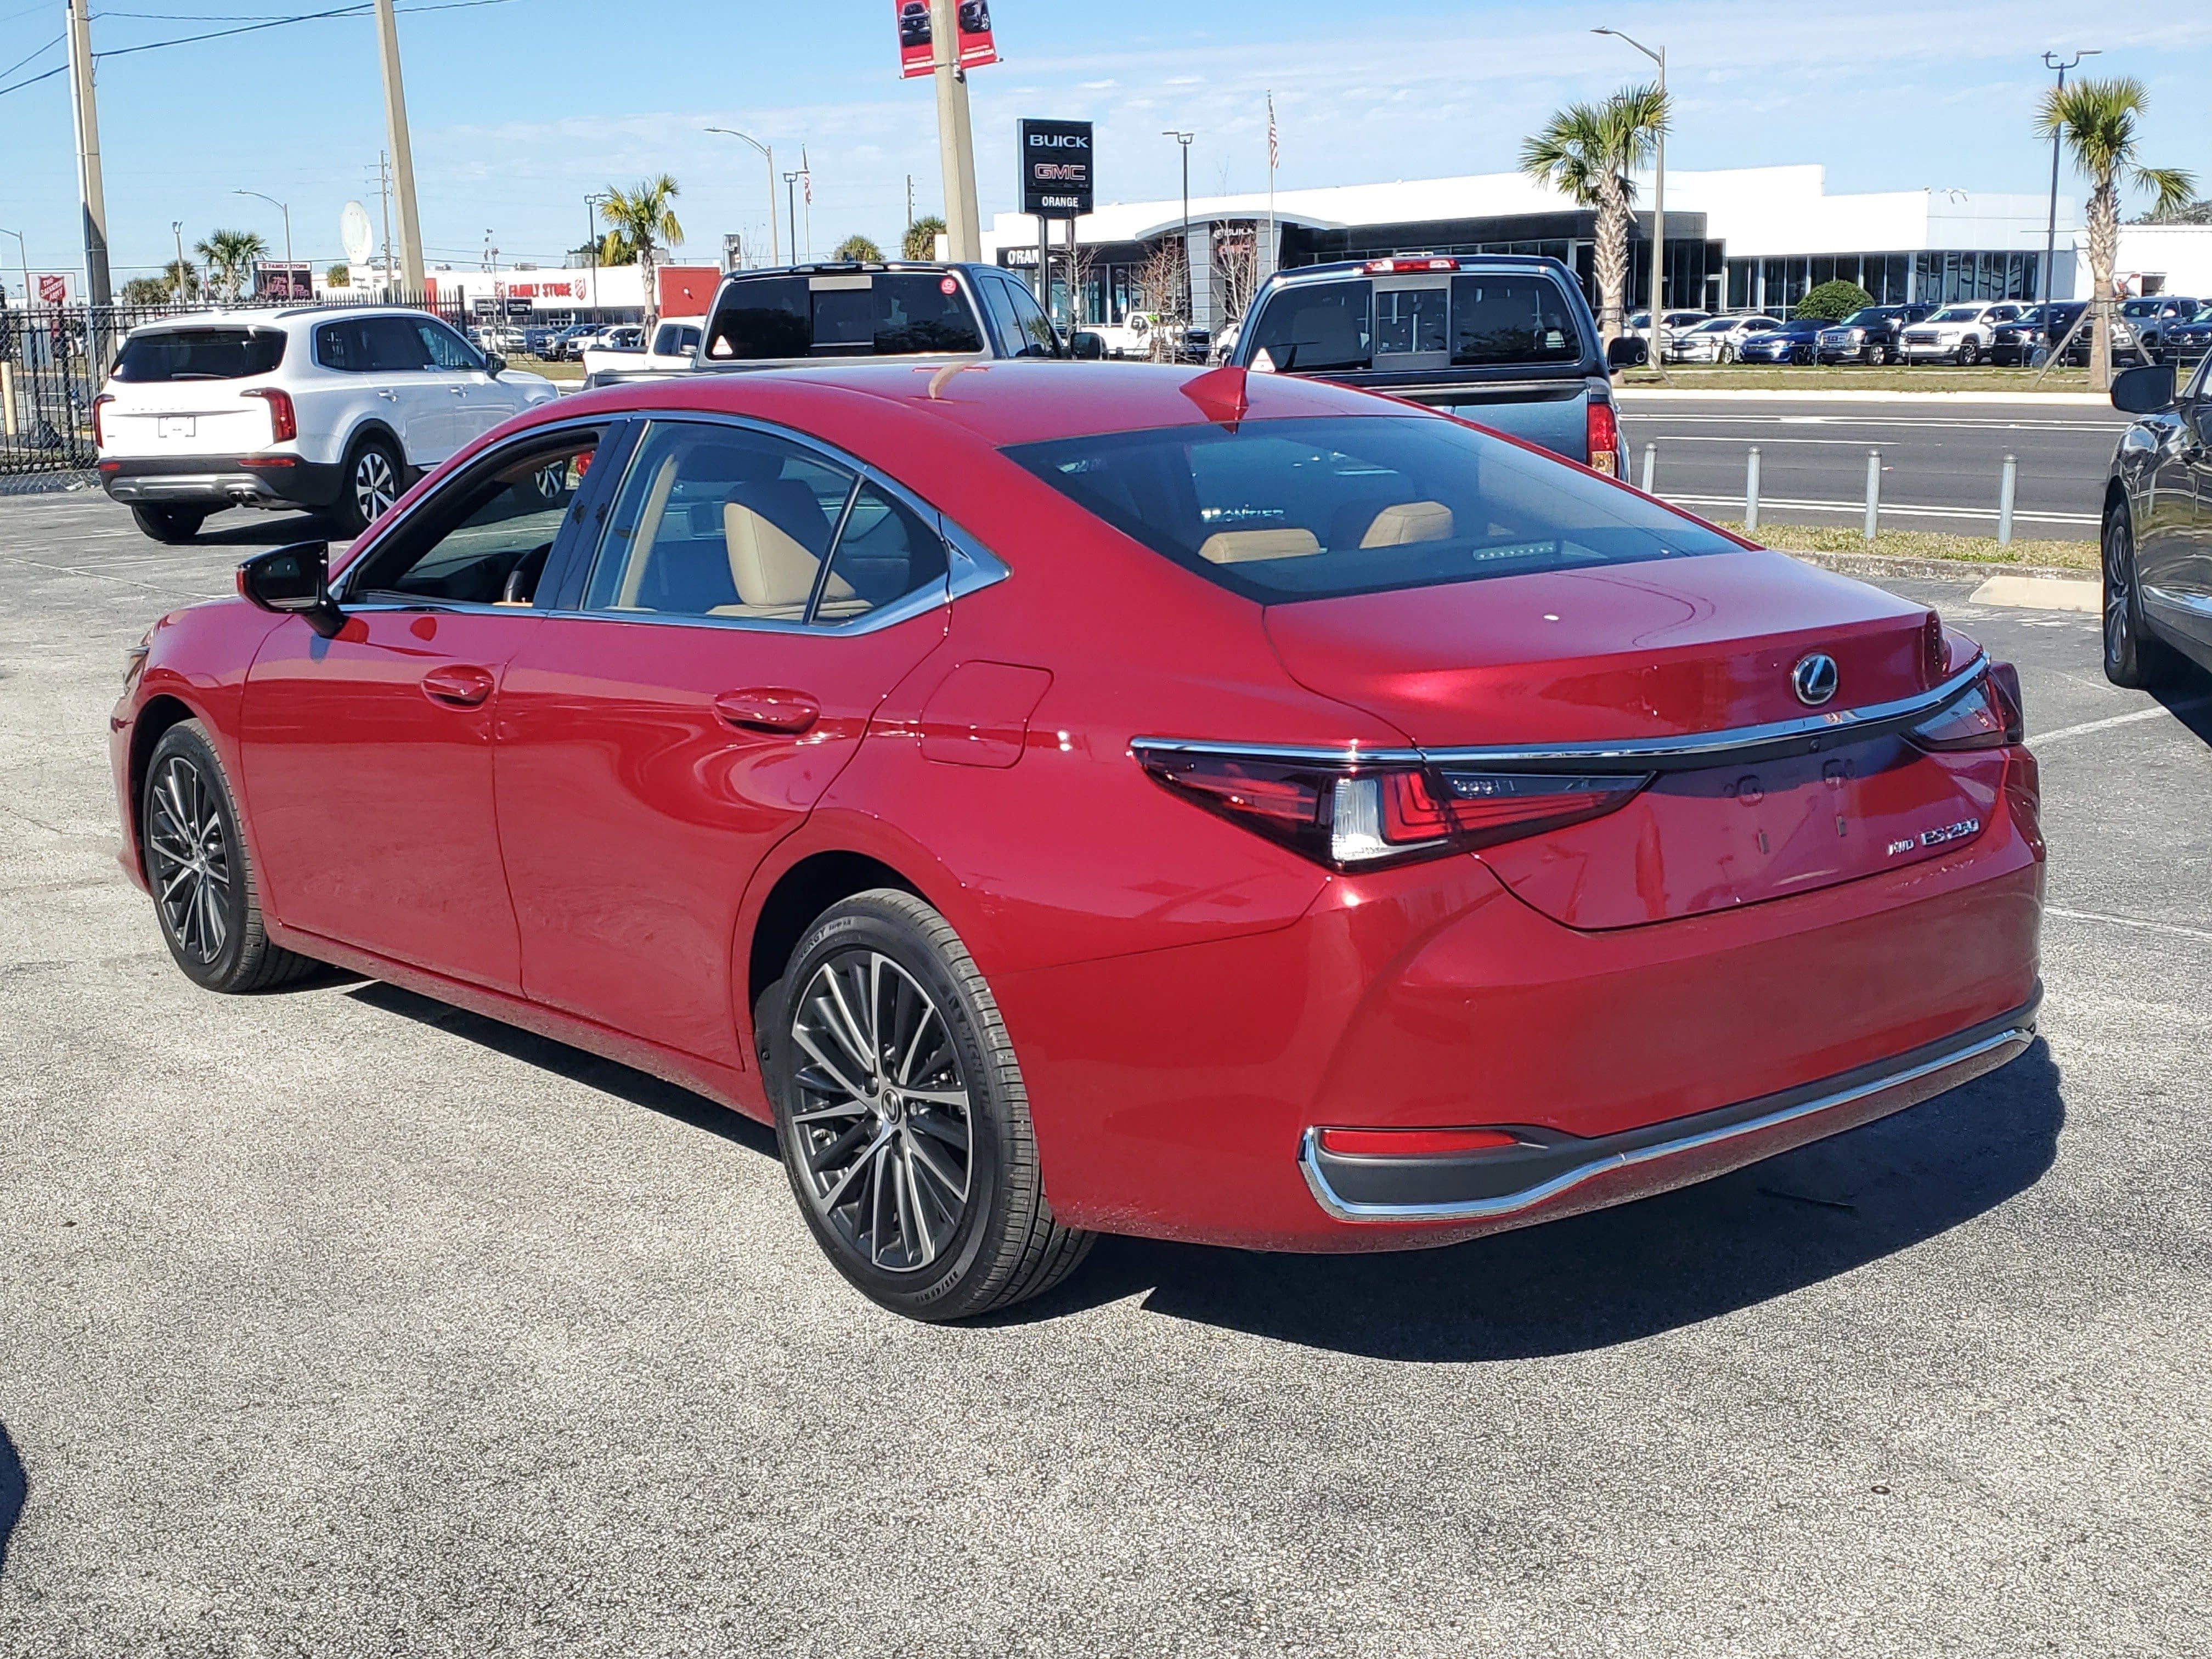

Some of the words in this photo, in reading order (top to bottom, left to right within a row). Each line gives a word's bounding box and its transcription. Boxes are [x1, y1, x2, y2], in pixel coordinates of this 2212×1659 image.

[1030, 134, 1089, 148] BUICK
[1035, 163, 1086, 180] GMC
[1042, 196, 1079, 207] ORANGE
[1007, 249, 1039, 265] ORAN
[43, 276, 54, 286] THE
[509, 284, 539, 297] FAMILY
[543, 283, 572, 297] STORE
